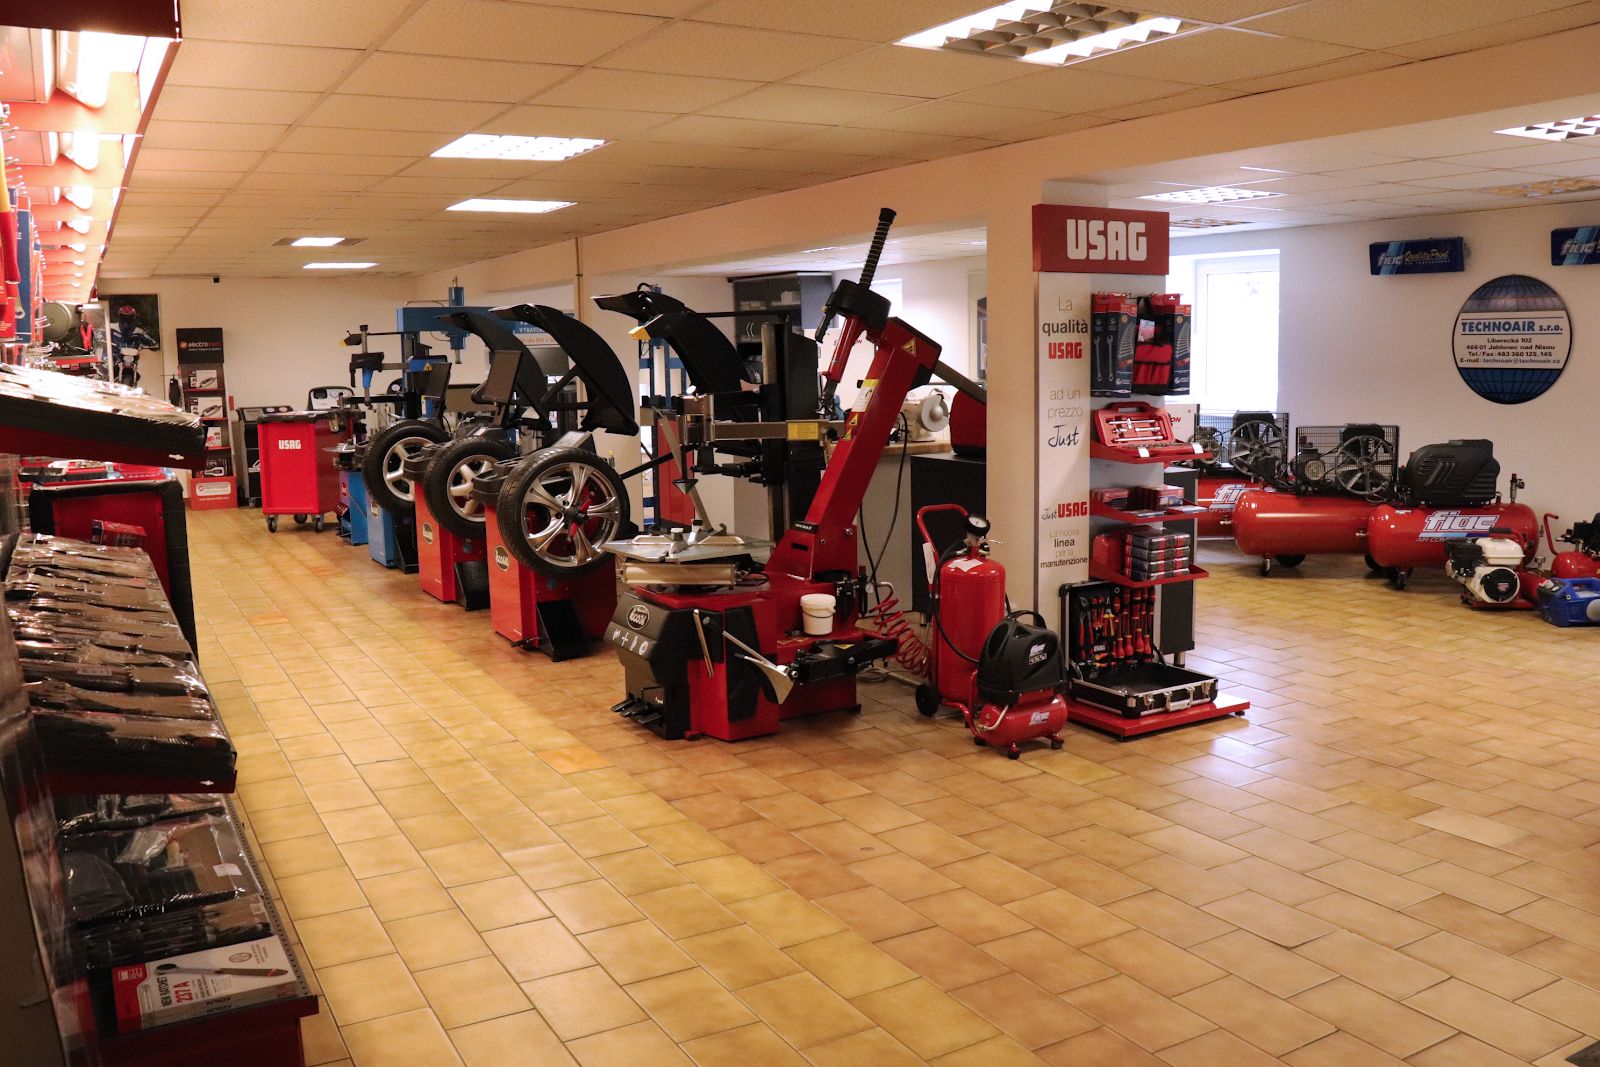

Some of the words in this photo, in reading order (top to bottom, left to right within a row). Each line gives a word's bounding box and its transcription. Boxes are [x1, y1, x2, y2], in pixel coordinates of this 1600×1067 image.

[1066, 218, 1147, 261] USAG
[1058, 296, 1073, 311] La
[1042, 318, 1088, 337] qualità
[1461, 320, 1536, 333] TECHNOAIR
[1538, 324, 1563, 332] s.r.o.
[1048, 341, 1083, 360] USAG
[1049, 388, 1064, 400] ad
[1067, 389, 1081, 400] un
[1047, 406, 1083, 421] prezzo
[1047, 423, 1080, 448] Just
[278, 439, 302, 450] USAG
[1057, 501, 1088, 518] USAG
[1423, 510, 1500, 532] fiac
[1054, 538, 1075, 548] linea
[1040, 557, 1088, 569] manutenzione
[175, 989, 194, 1004] 237
